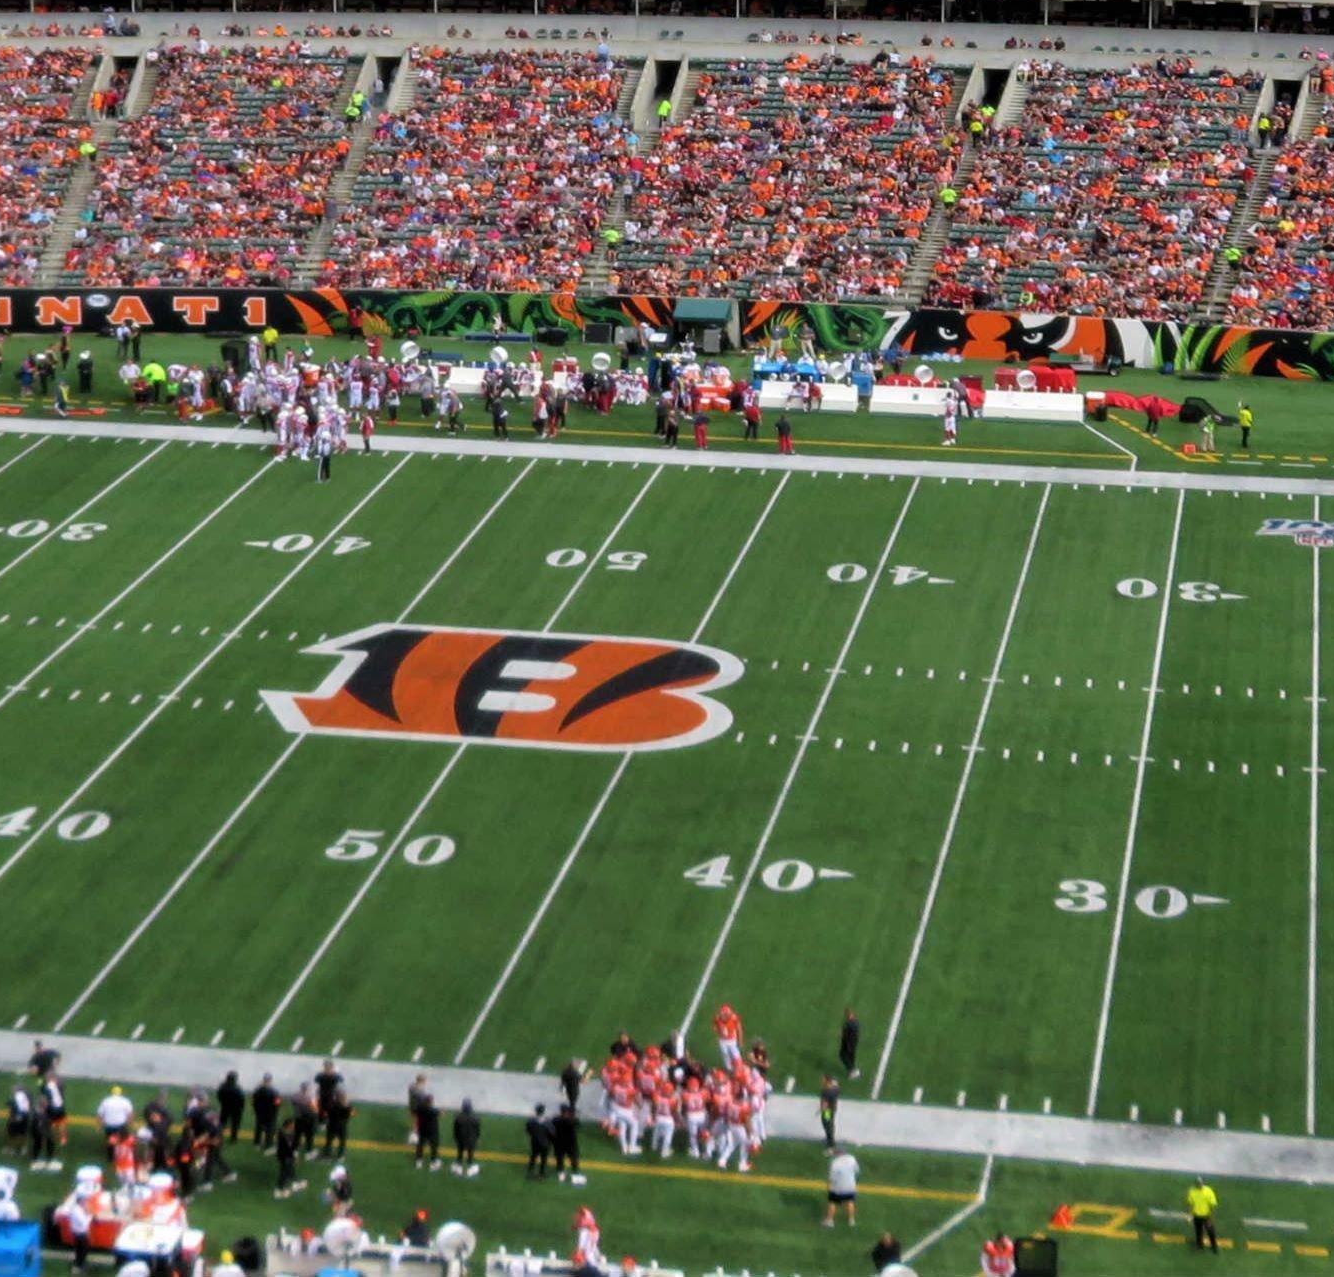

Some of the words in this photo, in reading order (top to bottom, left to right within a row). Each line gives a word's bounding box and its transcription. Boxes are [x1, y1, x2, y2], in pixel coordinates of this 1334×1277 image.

[5, 519, 108, 542] 30
[271, 532, 371, 555] 40
[546, 547, 649, 572] 50
[826, 562, 929, 586] 40
[1116, 577, 1221, 603] 30
[324, 828, 456, 867] 50
[683, 854, 817, 894] 40
[1054, 877, 1189, 919] 30
